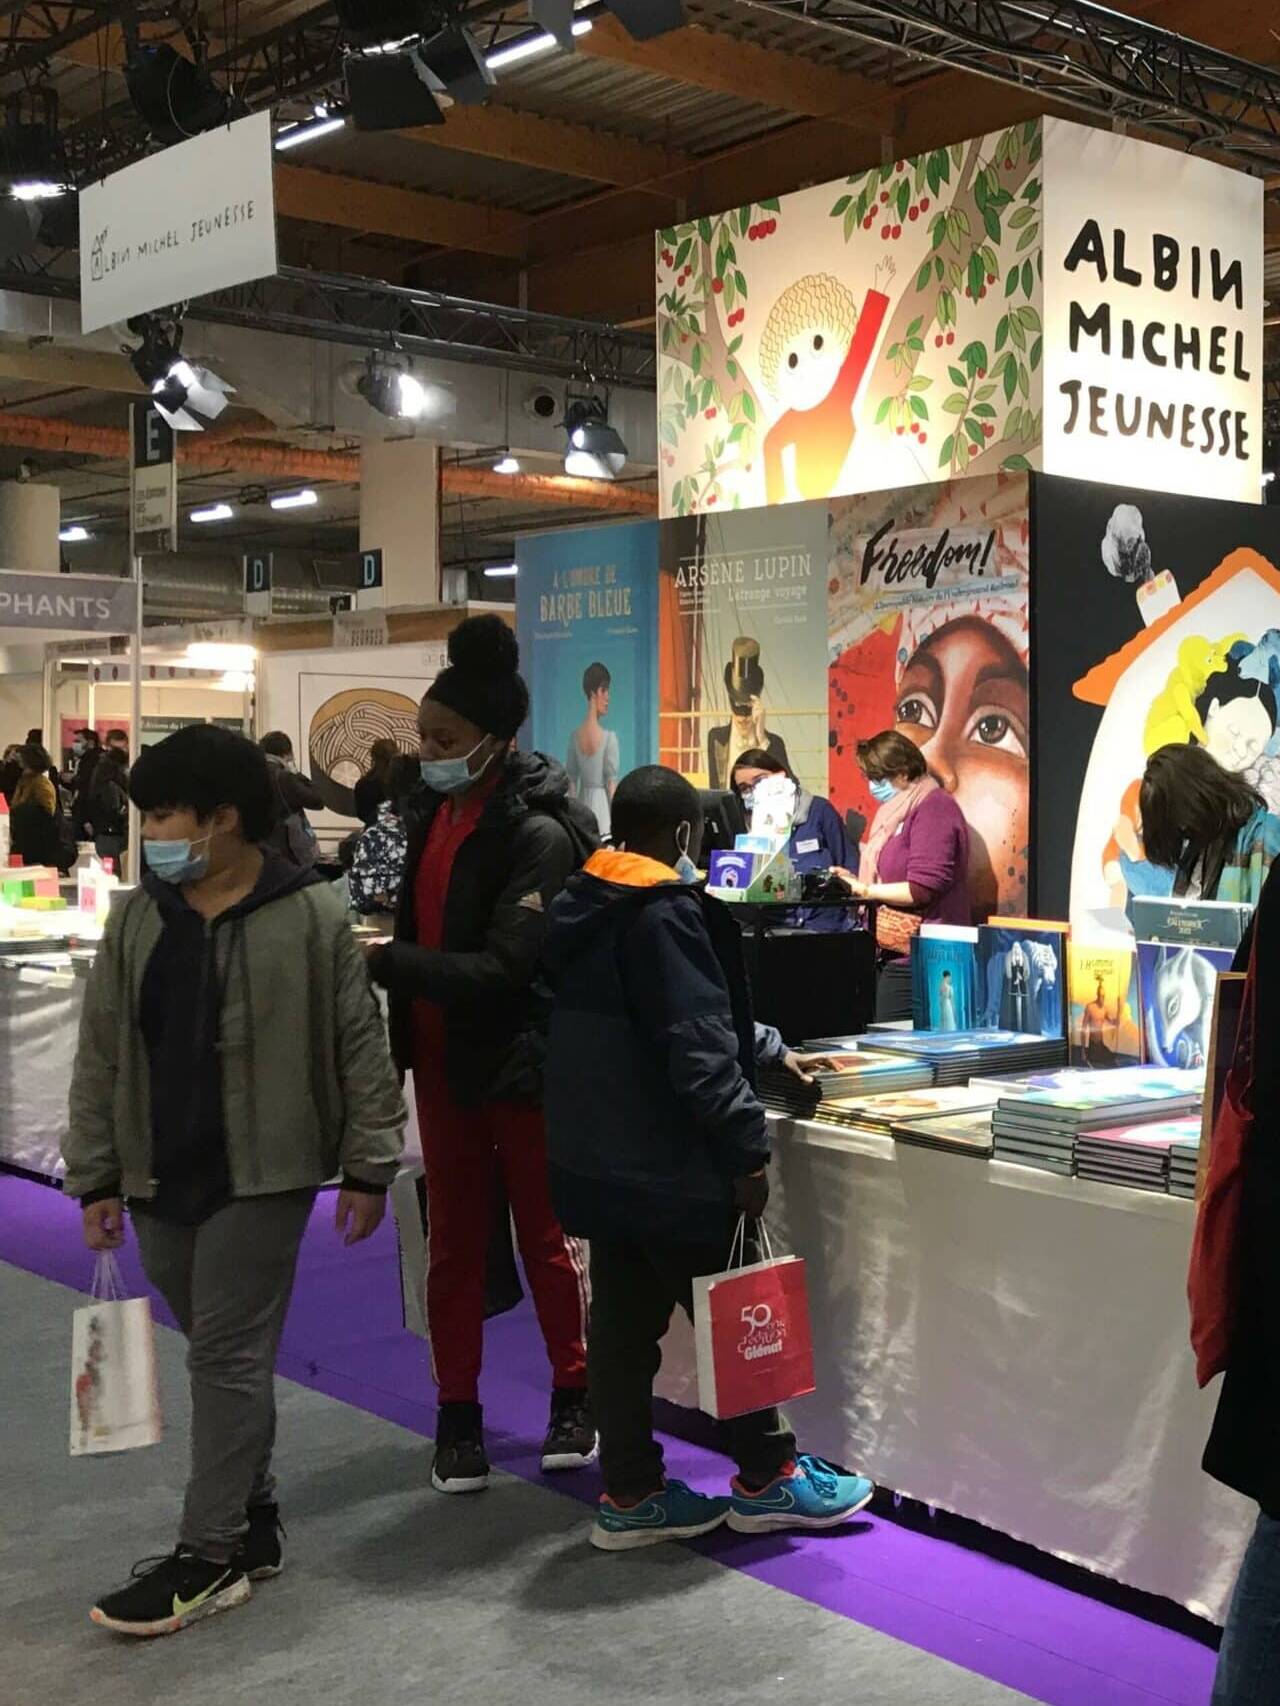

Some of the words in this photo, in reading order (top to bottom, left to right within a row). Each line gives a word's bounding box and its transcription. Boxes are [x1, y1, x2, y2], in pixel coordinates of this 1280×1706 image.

[138, 230, 179, 258] MICHEL
[190, 200, 254, 242] JEUNESSE
[1063, 218, 1243, 310] ALBIN
[1069, 300, 1251, 382] MICHEL
[146, 407, 161, 461] E
[1059, 379, 1250, 460] JEUNESSE
[254, 558, 264, 589] D
[363, 554, 376, 585] D
[673, 559, 745, 588] ARSÈNE
[754, 553, 812, 581] LUPIN
[860, 518, 997, 589] Freedom!
[540, 592, 583, 628] BARBE
[588, 587, 632, 618] BLEUE
[741, 1304, 772, 1337] 50
[744, 1339, 783, 1361] Glénat
